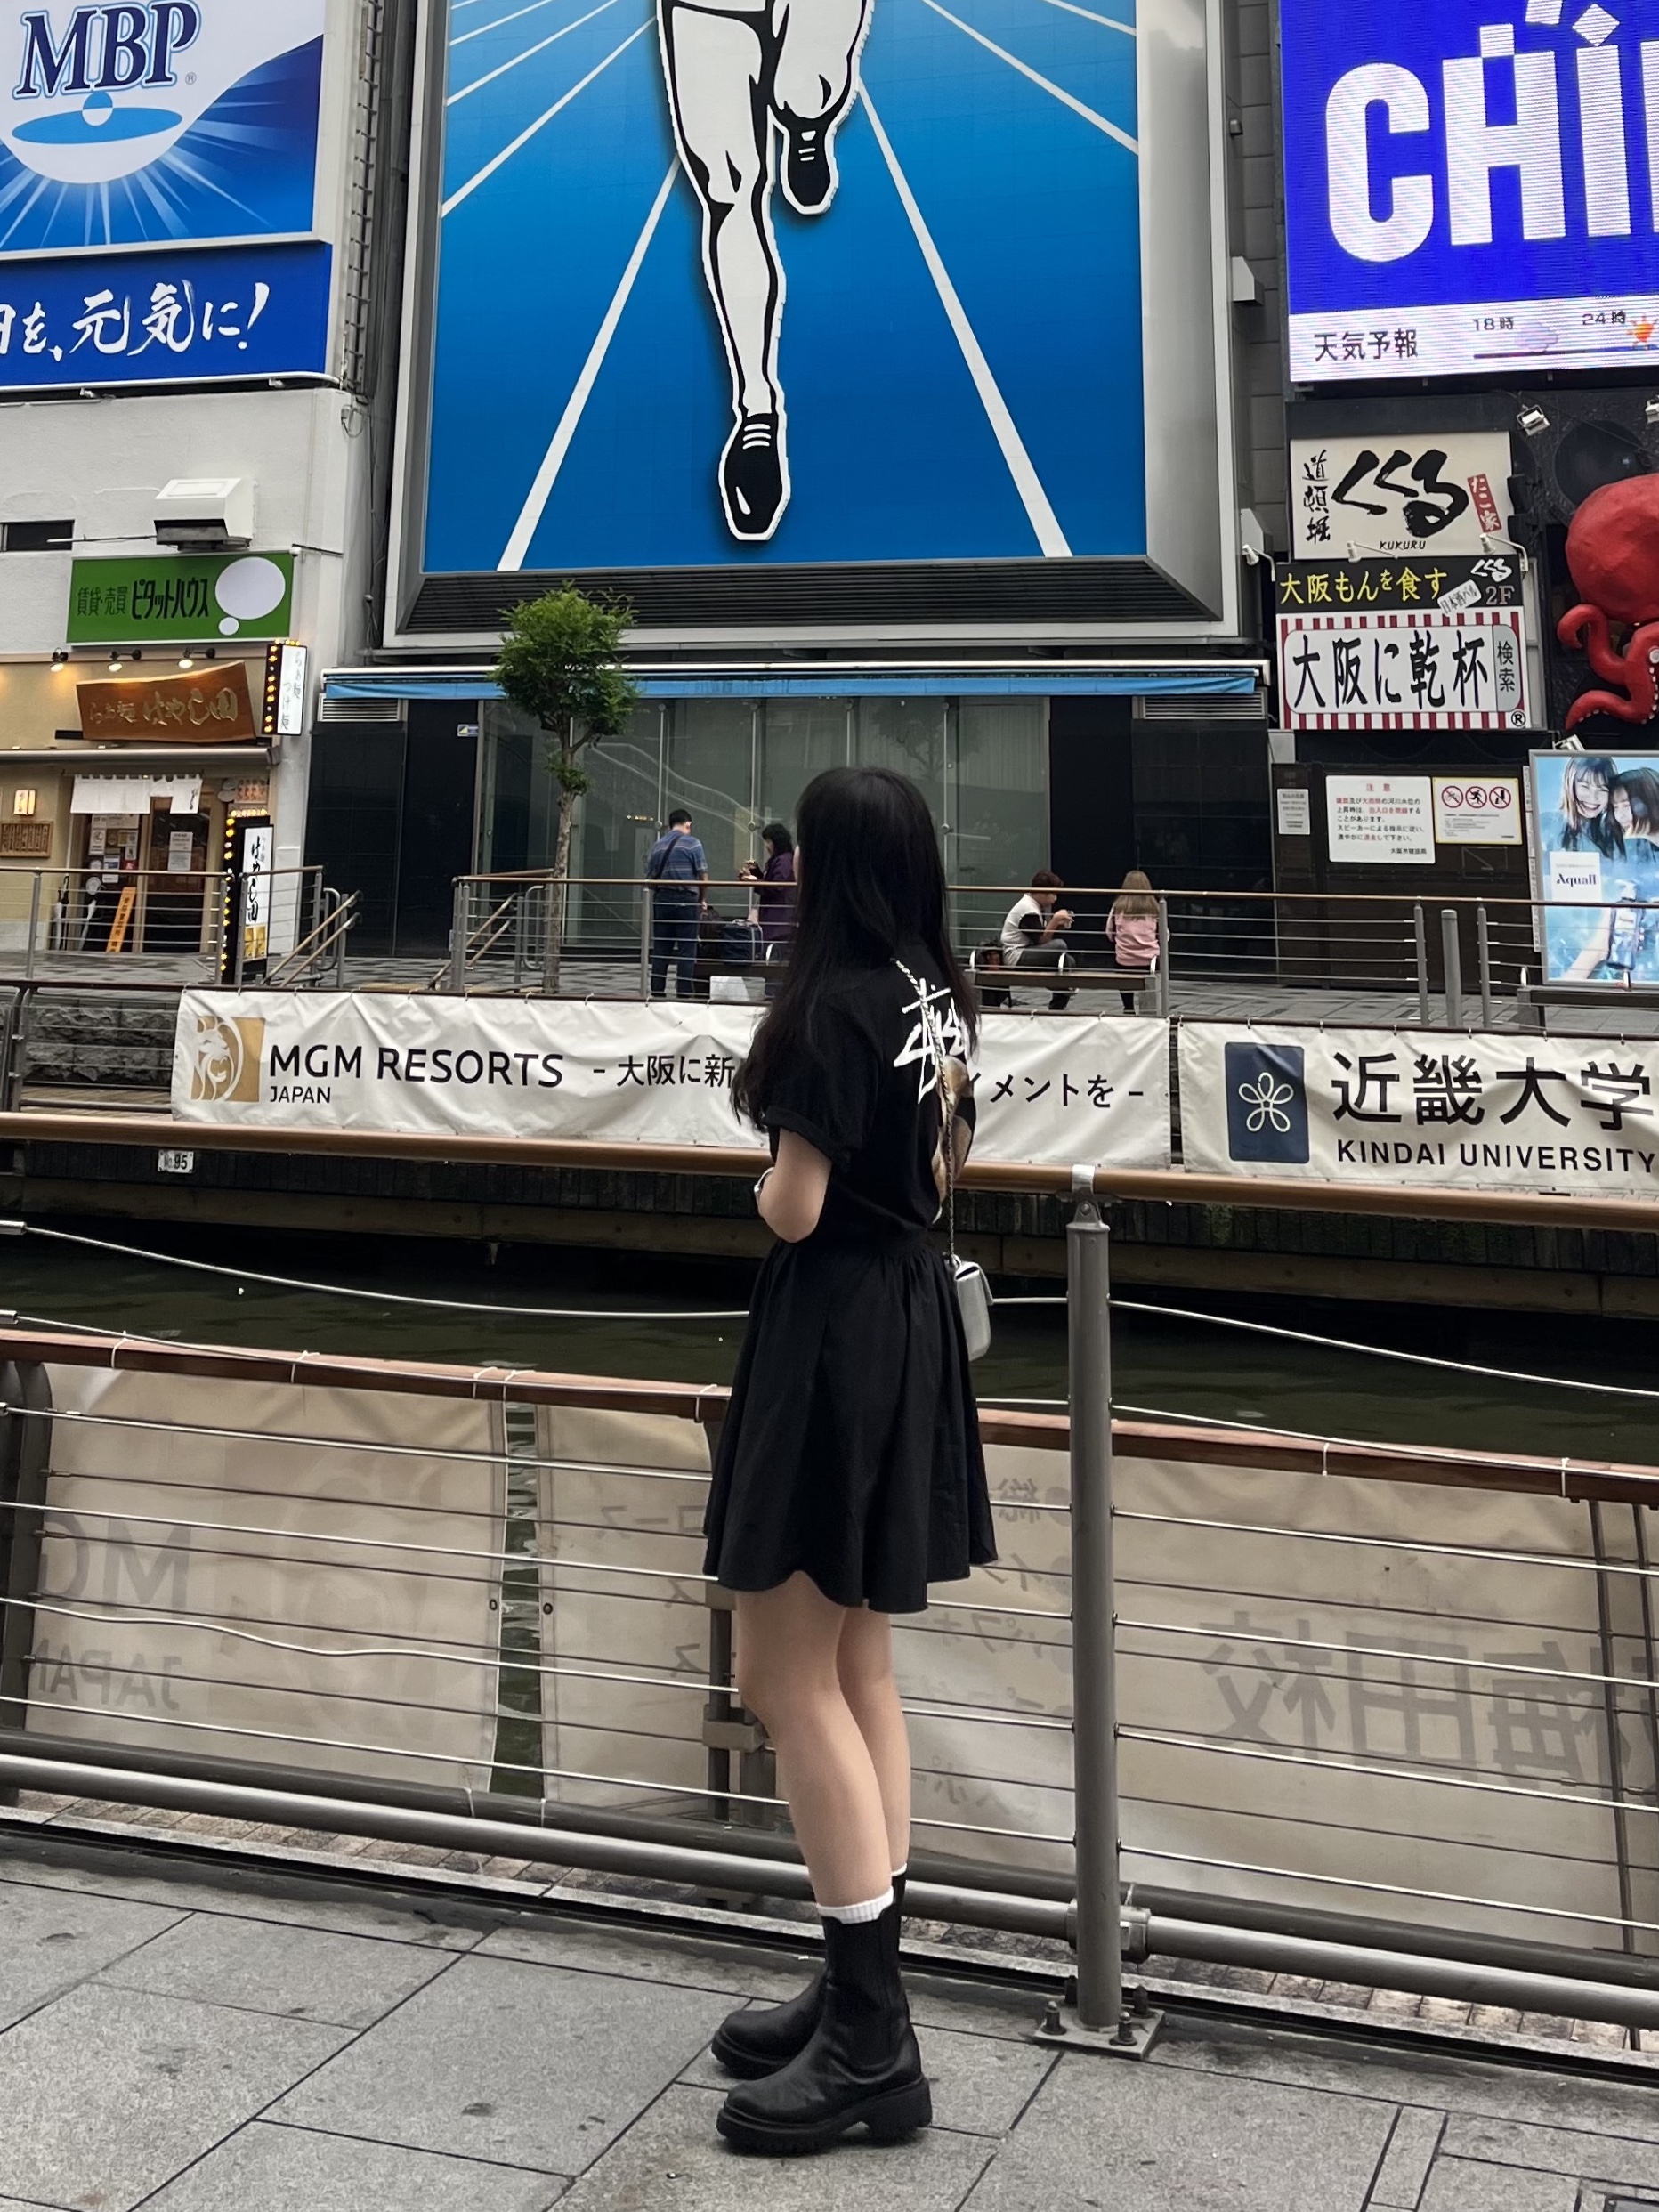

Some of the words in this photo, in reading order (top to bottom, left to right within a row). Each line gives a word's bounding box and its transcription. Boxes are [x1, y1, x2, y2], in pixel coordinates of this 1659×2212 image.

[14, 2, 199, 97] MBP
[1315, 328, 1418, 361] 天気予報
[1302, 450, 1331, 544] 道頓堀
[1331, 449, 1469, 538] くくる
[1470, 476, 1501, 531] たこ家
[1379, 539, 1427, 550] KUKURU
[1280, 566, 1448, 604] 大阪もんを食す
[1470, 558, 1512, 582] くくる
[132, 575, 209, 620] ピタットハウス
[1485, 585, 1515, 605] 2F
[1292, 629, 1489, 709] 大阪に乾杯
[1497, 641, 1516, 692] 検索
[270, 1044, 362, 1079] MGM
[377, 1048, 564, 1089] RESORTS
[617, 1054, 735, 1089] 大阪に新
[270, 1085, 331, 1105] JAPAN
[1331, 1051, 1654, 1131] 近畿大学
[1337, 1138, 1445, 1166] KINDAI
[1461, 1143, 1656, 1173] UNIVERSITY
